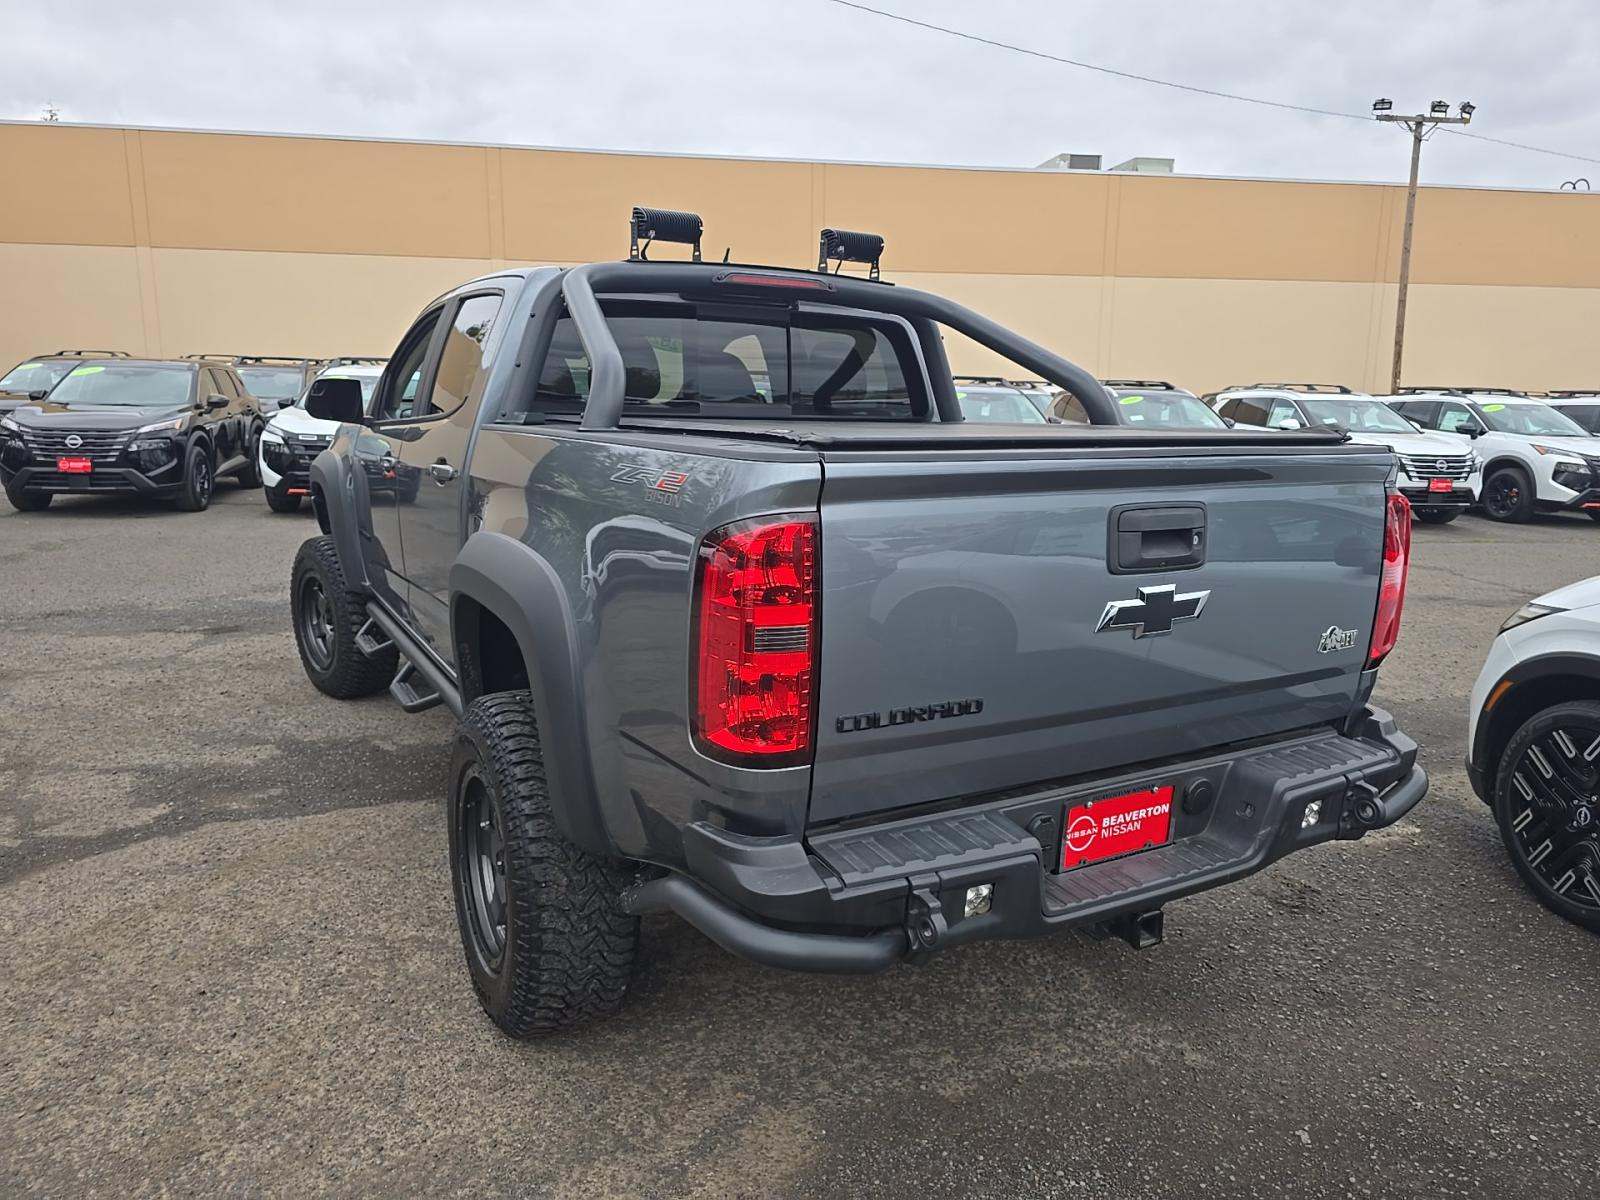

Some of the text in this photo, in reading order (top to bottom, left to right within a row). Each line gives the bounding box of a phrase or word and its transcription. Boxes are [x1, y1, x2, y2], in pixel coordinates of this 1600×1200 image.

[610, 463, 689, 493] ZR2
[836, 697, 984, 733] COLORADO
[1102, 803, 1169, 828] BEAVERTON
[1101, 820, 1141, 839] NISSAN
